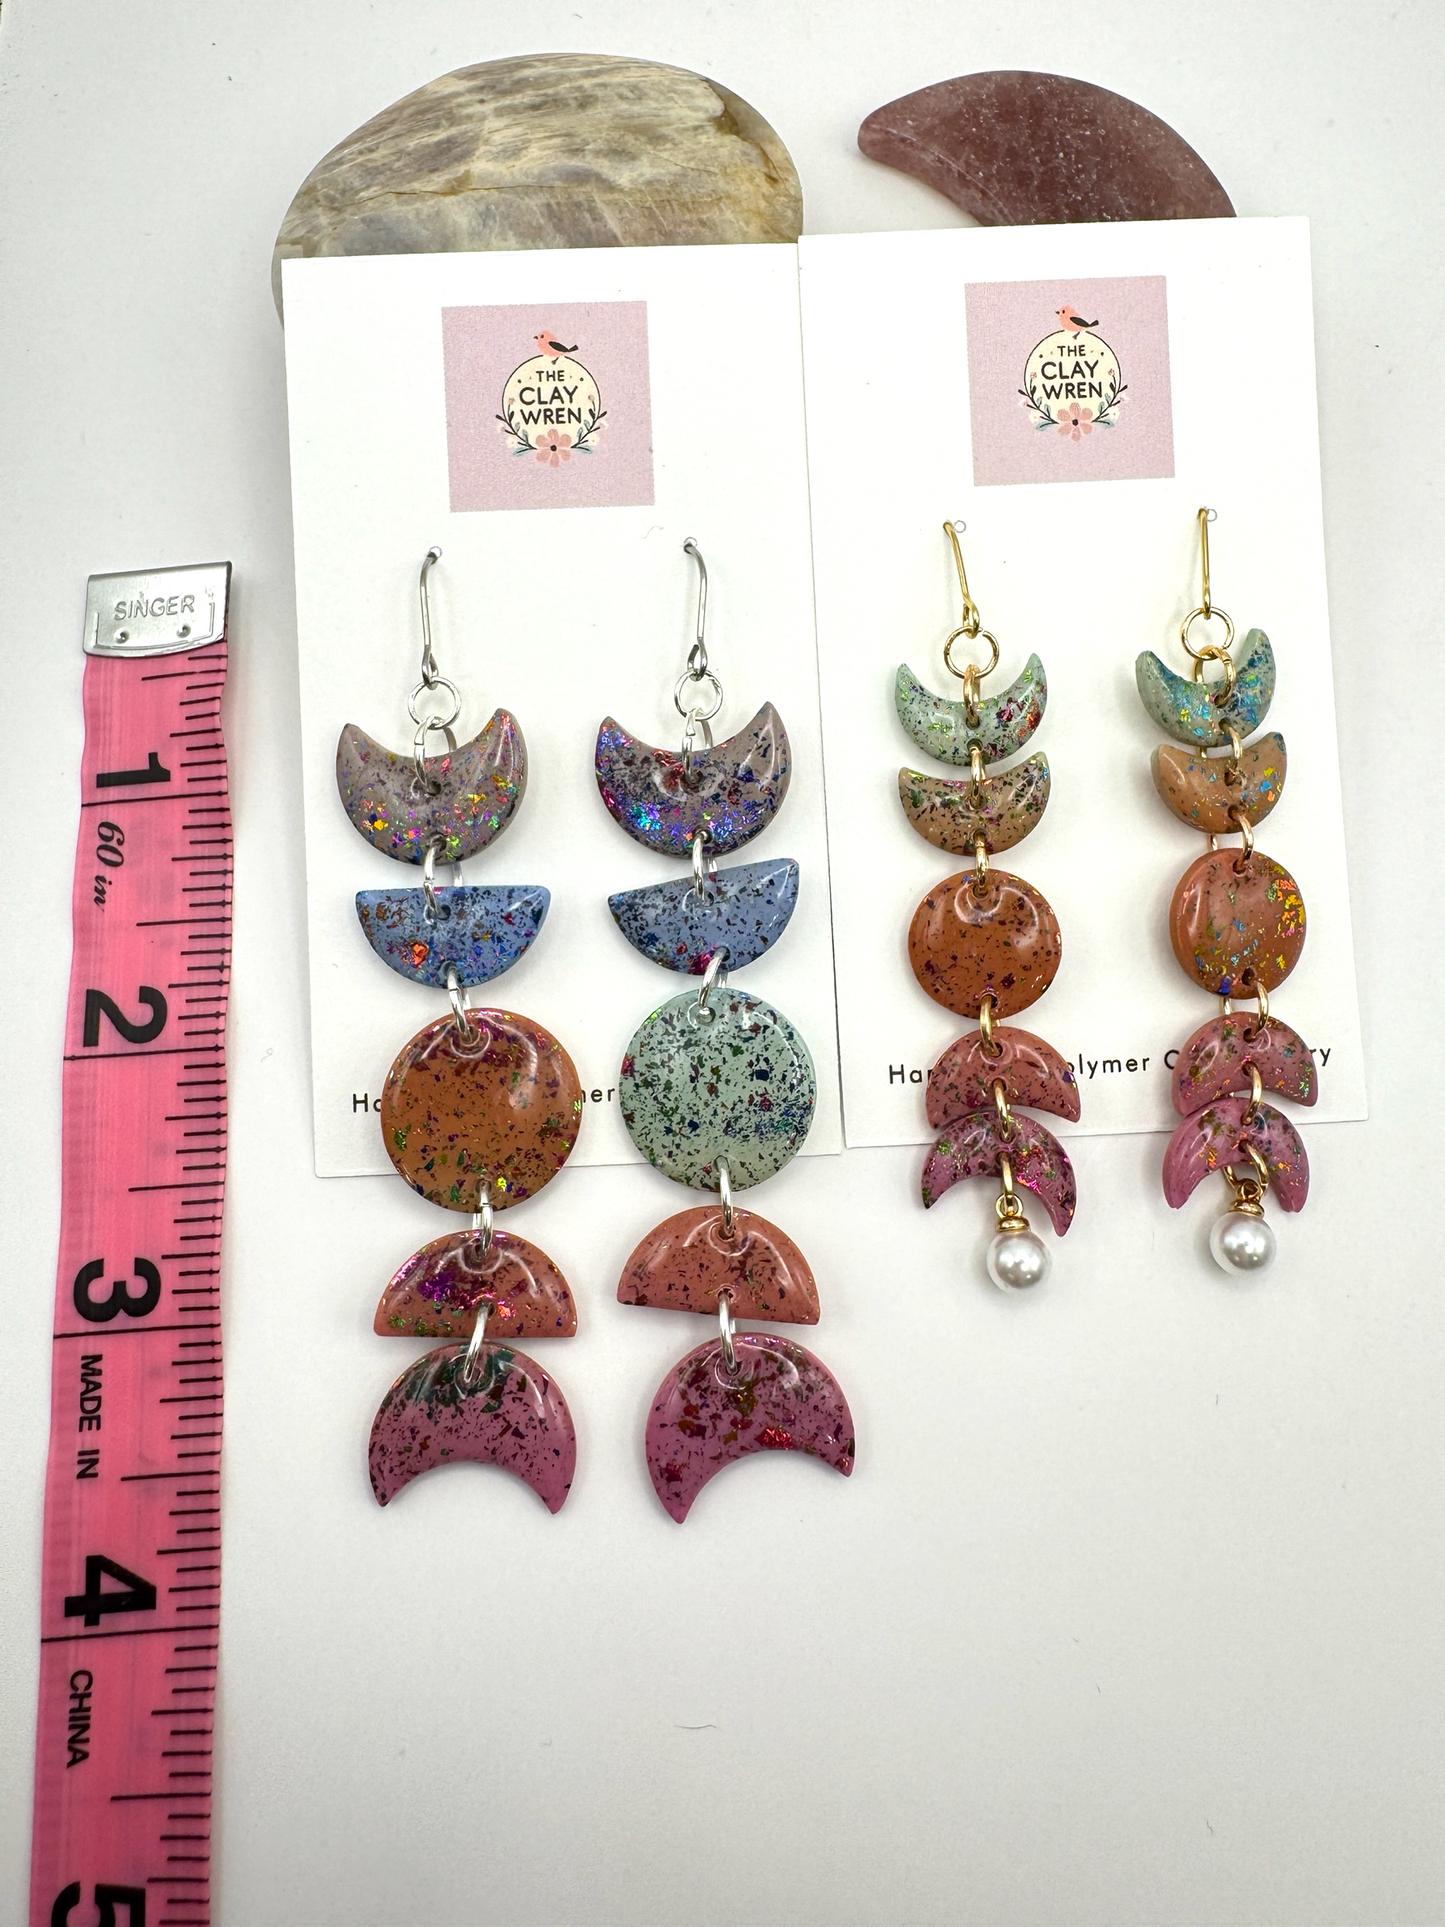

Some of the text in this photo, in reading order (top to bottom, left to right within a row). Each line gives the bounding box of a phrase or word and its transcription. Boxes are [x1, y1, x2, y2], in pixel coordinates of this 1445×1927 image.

[1056, 344, 1086, 357] THE
[535, 369, 565, 383] THE
[1040, 359, 1099, 381] CLAY
[519, 385, 579, 406] CLAY
[1041, 381, 1103, 400] WREN
[519, 407, 582, 426] WREN
[113, 594, 195, 621] SINGER
[96, 751, 171, 788] 1
[93, 820, 125, 912] 60 in
[83, 985, 168, 1047] 2
[1067, 1053, 1150, 1080] lymer
[73, 1257, 162, 1323] 3
[76, 1353, 104, 1480] MADE IN
[64, 1554, 157, 1627] 4
[66, 1669, 94, 1770] CHINA
[50, 1881, 147, 1927] 5
